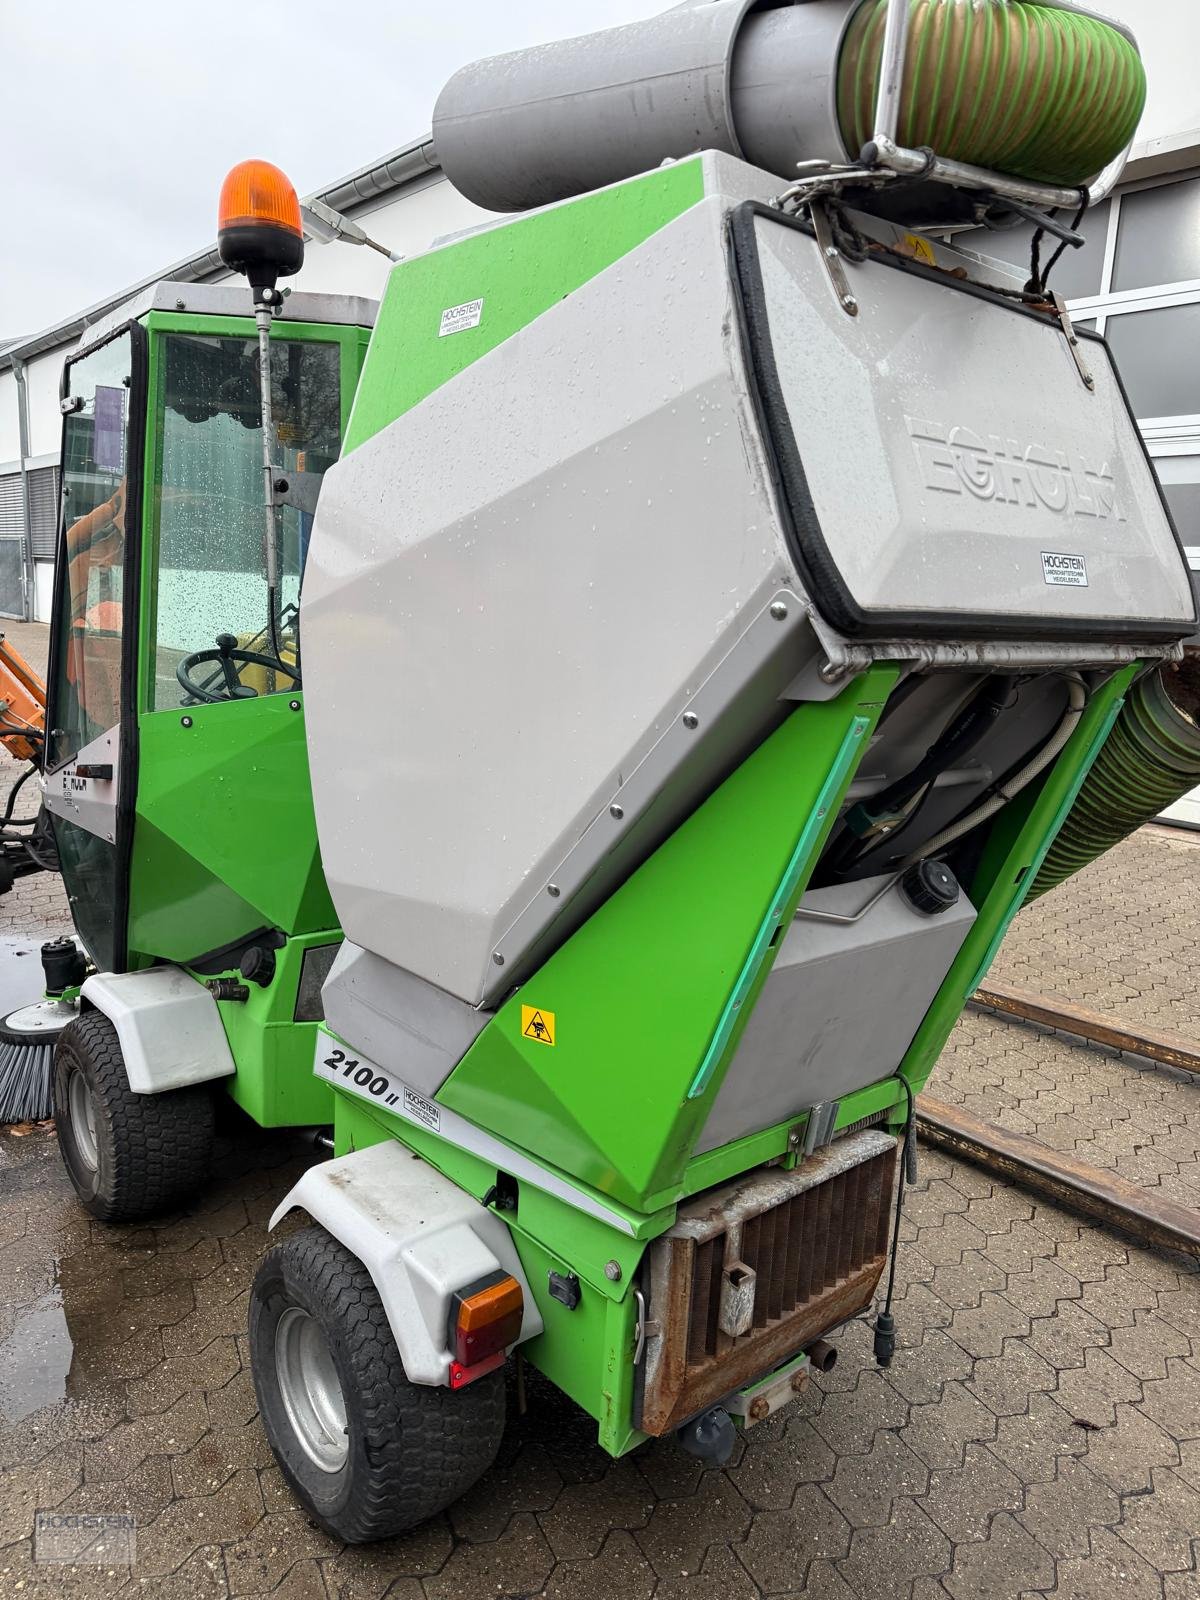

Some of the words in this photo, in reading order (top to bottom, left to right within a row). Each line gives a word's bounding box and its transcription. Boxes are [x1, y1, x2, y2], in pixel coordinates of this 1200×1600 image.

[443, 301, 481, 321] HOCHSTEIN
[904, 415, 1127, 522] EGHOLM
[1043, 555, 1084, 570] HOCHSTEIN
[323, 1049, 390, 1096] 2100
[405, 1090, 439, 1118] HOCHSTEIN
